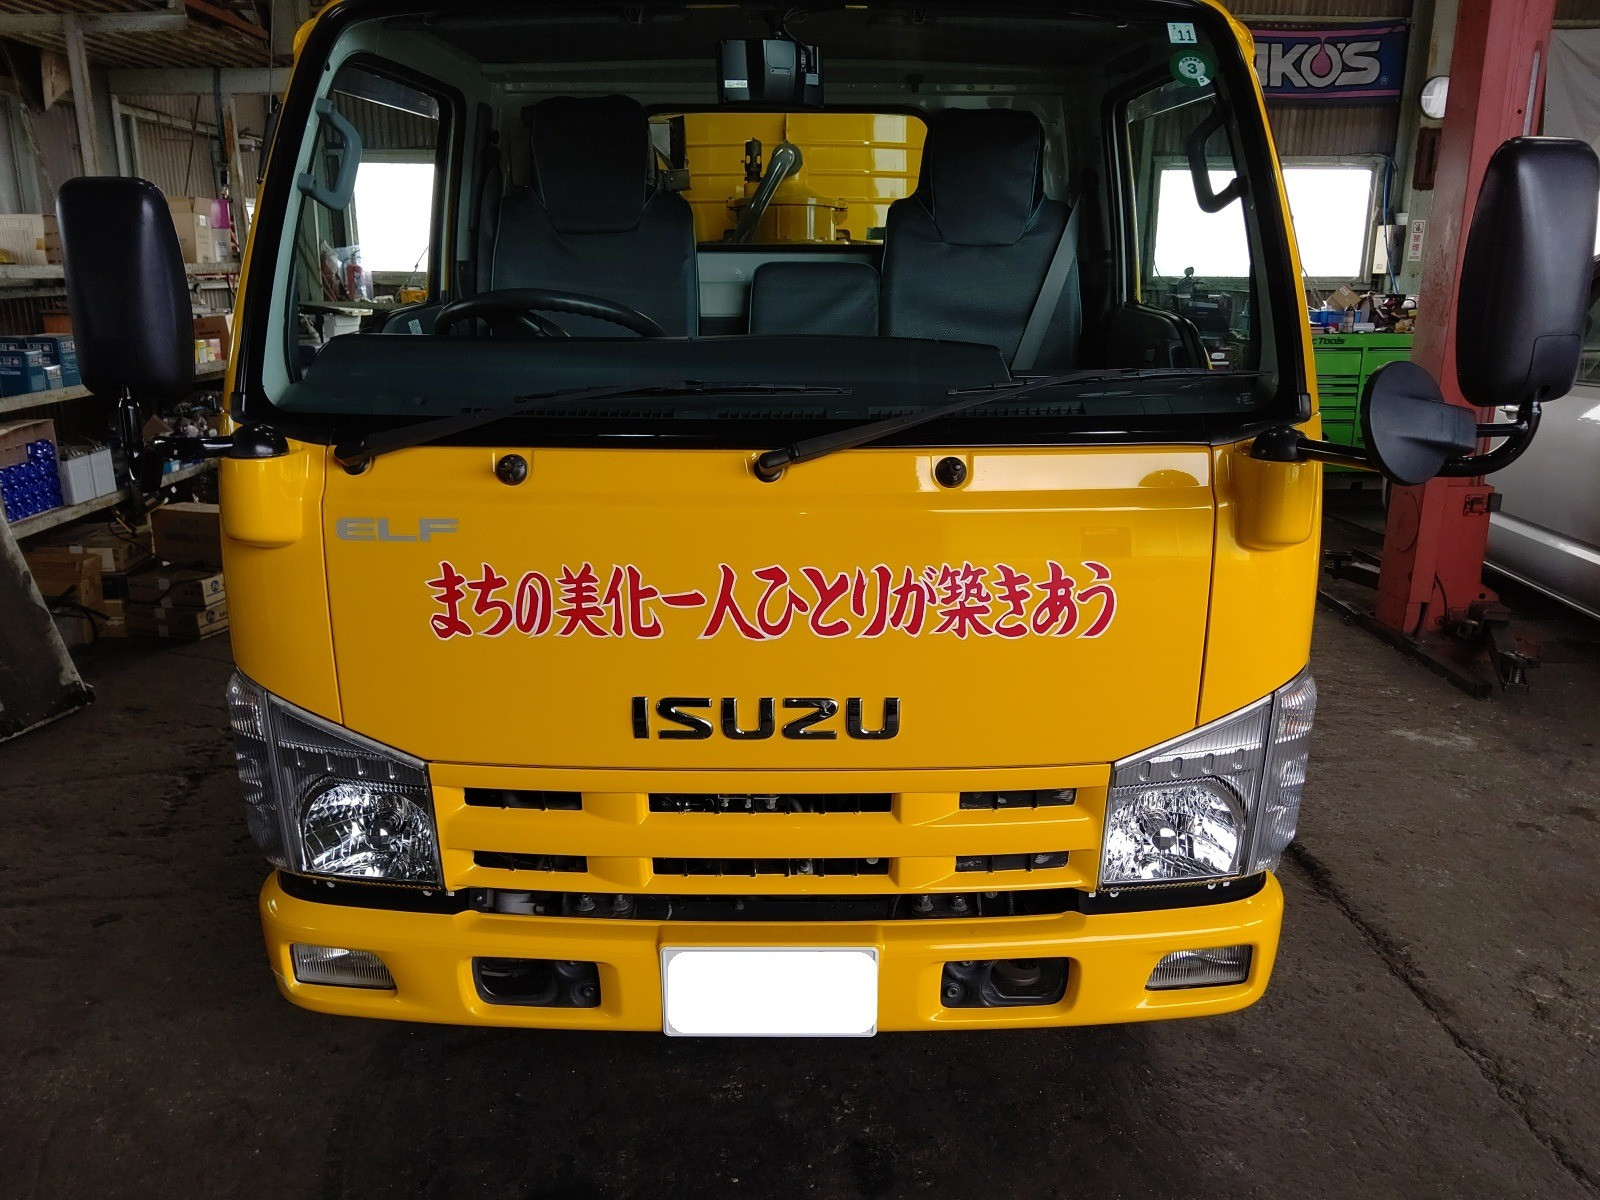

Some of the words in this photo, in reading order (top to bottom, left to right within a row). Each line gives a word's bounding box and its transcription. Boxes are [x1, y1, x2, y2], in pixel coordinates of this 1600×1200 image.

[1178, 29, 1194, 41] 11
[1187, 63, 1198, 74] 3
[336, 517, 458, 542] ELF
[425, 560, 1118, 641] まちの美化一人ひとりが築きあう
[631, 696, 901, 741] ISUZU
